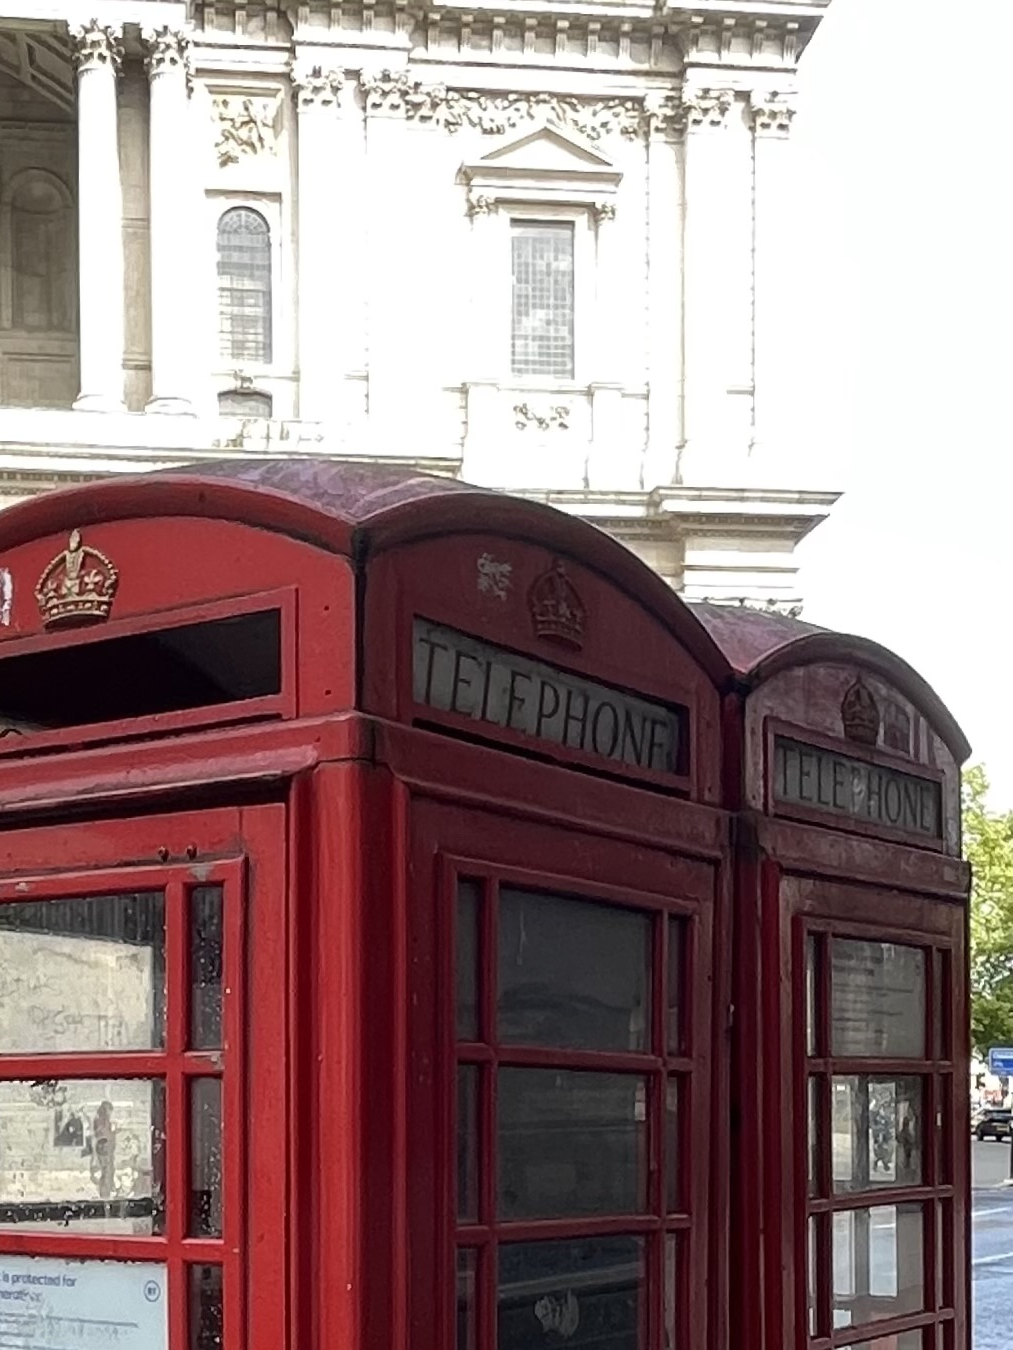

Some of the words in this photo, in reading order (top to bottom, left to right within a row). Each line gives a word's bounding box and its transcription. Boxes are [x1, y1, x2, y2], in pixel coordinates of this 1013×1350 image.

[419, 637, 669, 769] TELEPHONE
[777, 745, 933, 833] TELEPHONE
[11, 1272, 60, 1286] protected
[62, 1274, 77, 1287] for
